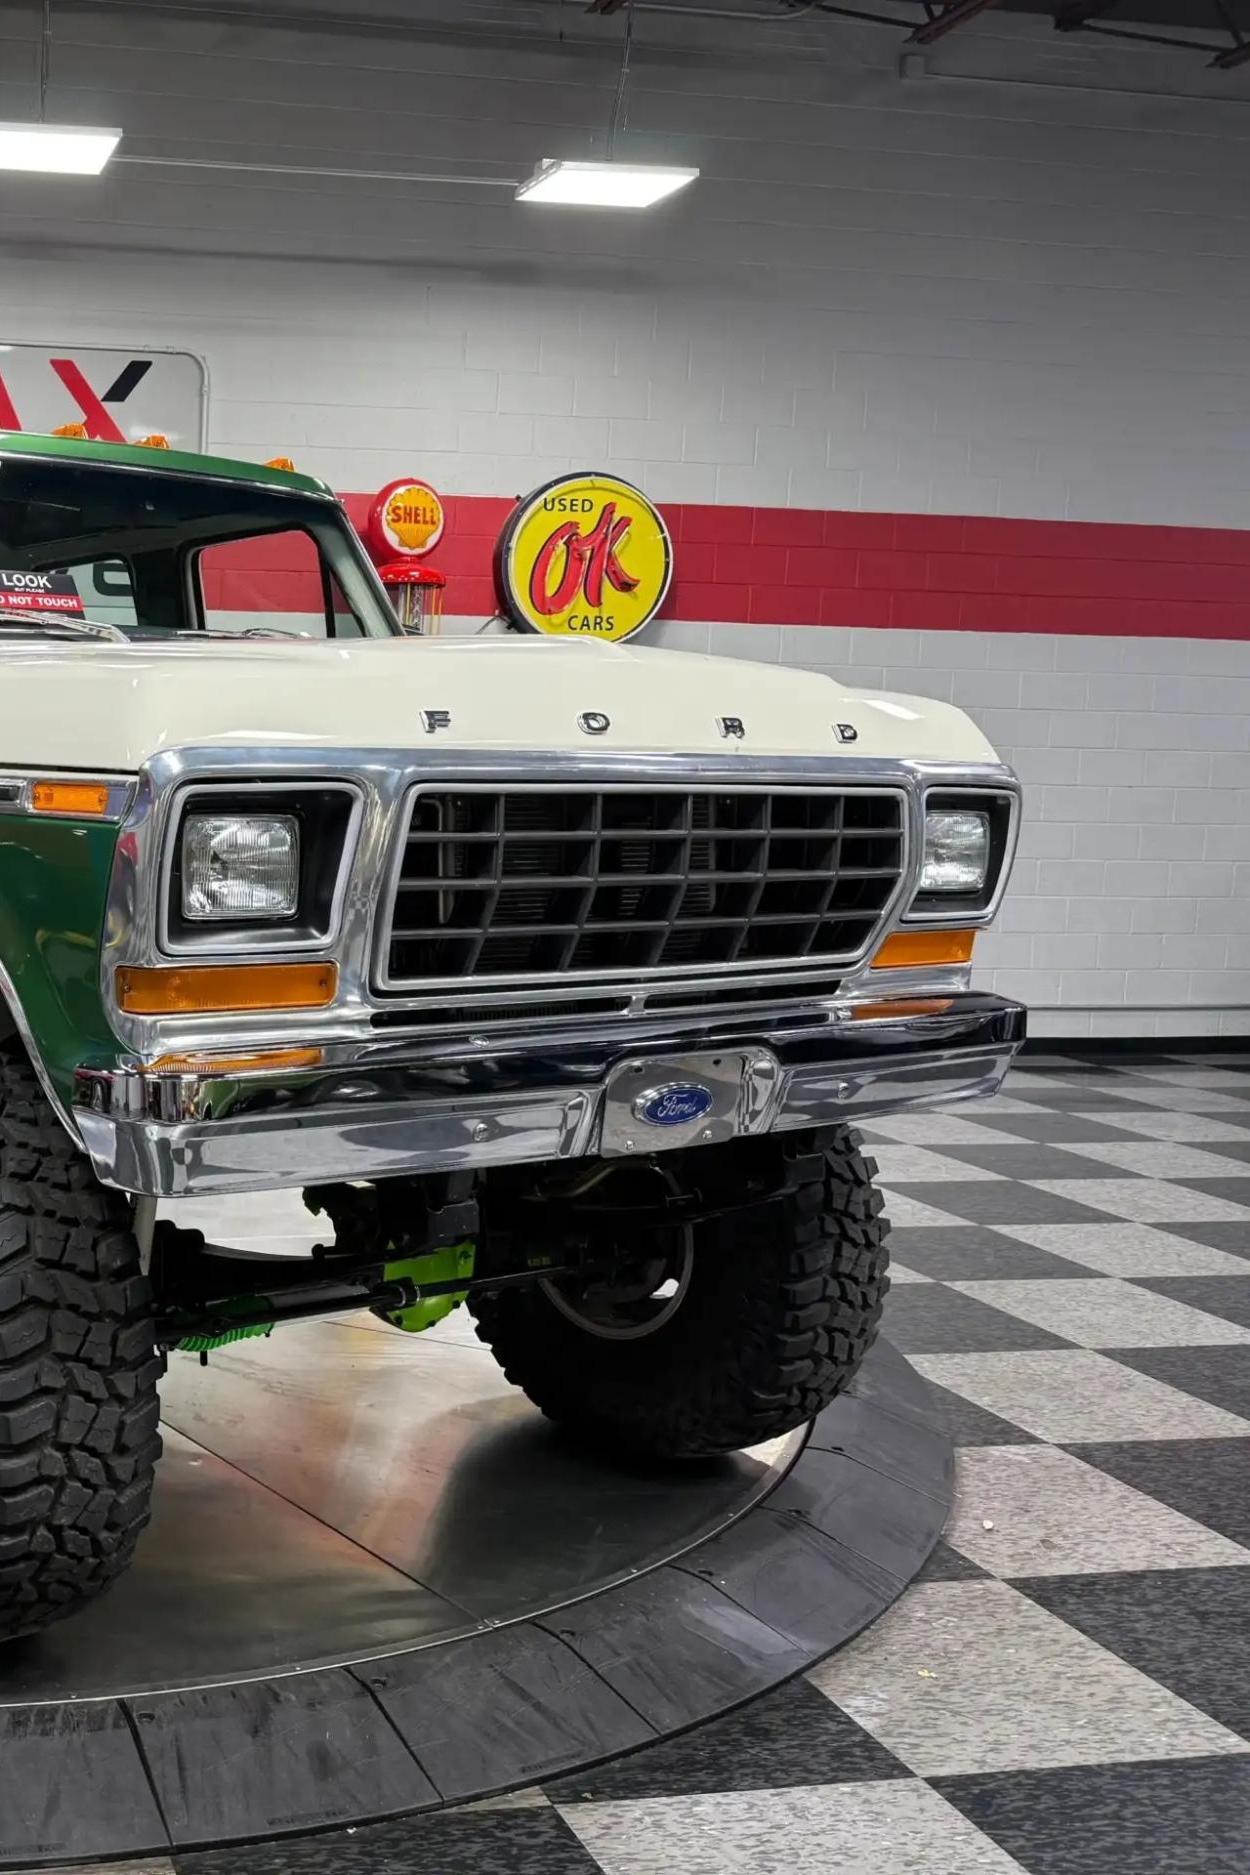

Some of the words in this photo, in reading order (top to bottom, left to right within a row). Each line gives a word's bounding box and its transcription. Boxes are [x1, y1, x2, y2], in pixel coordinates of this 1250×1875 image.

[543, 497, 594, 514] USED
[391, 505, 437, 525] SHELL
[529, 502, 640, 615] OK
[2, 573, 52, 588] LOOK
[8, 596, 32, 606] NOT
[36, 597, 78, 608] TOUCH
[567, 616, 614, 631] CARS
[420, 709, 857, 744] FORD
[658, 1094, 699, 1117] Ford
